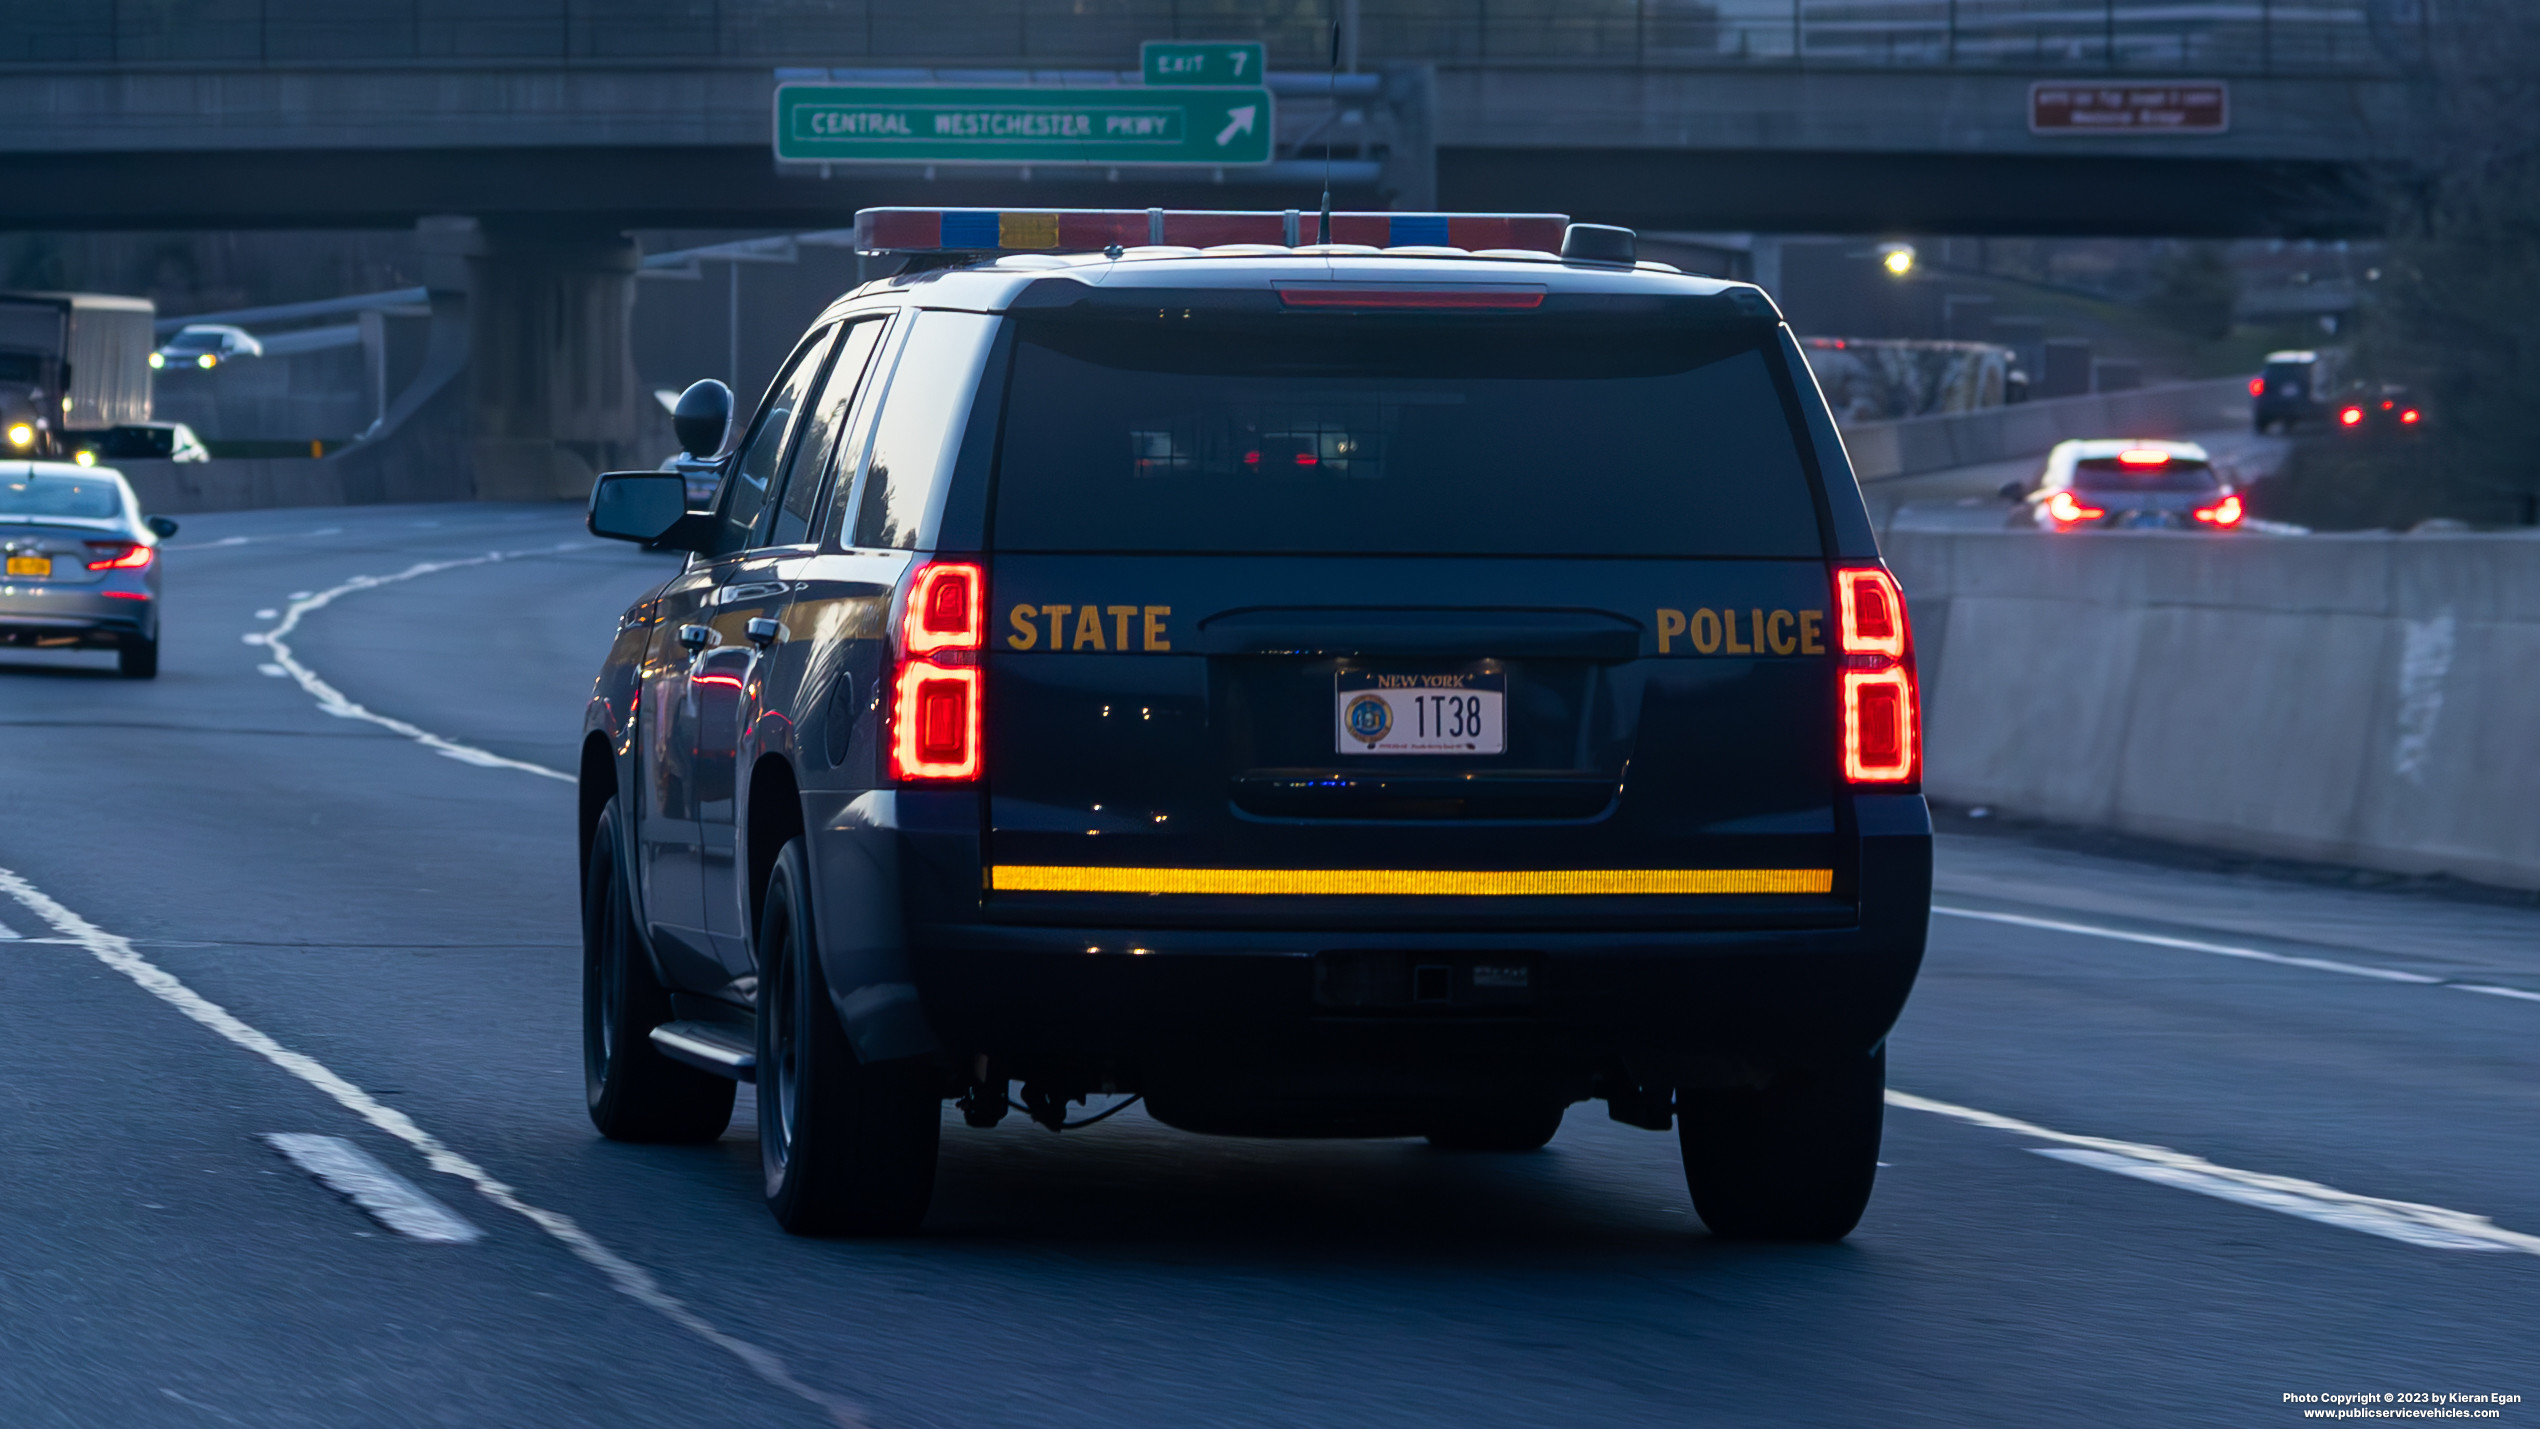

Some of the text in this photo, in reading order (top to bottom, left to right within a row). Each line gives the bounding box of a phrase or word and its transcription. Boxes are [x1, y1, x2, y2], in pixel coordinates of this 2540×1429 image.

[1158, 51, 1248, 77] EXIT 7
[811, 112, 1167, 136] CENTRAL WESTCHESTER PKWY
[1007, 603, 1825, 655] STATE POLICE
[1378, 674, 1465, 689] NEW YORK
[1414, 695, 1482, 738] 1T38
